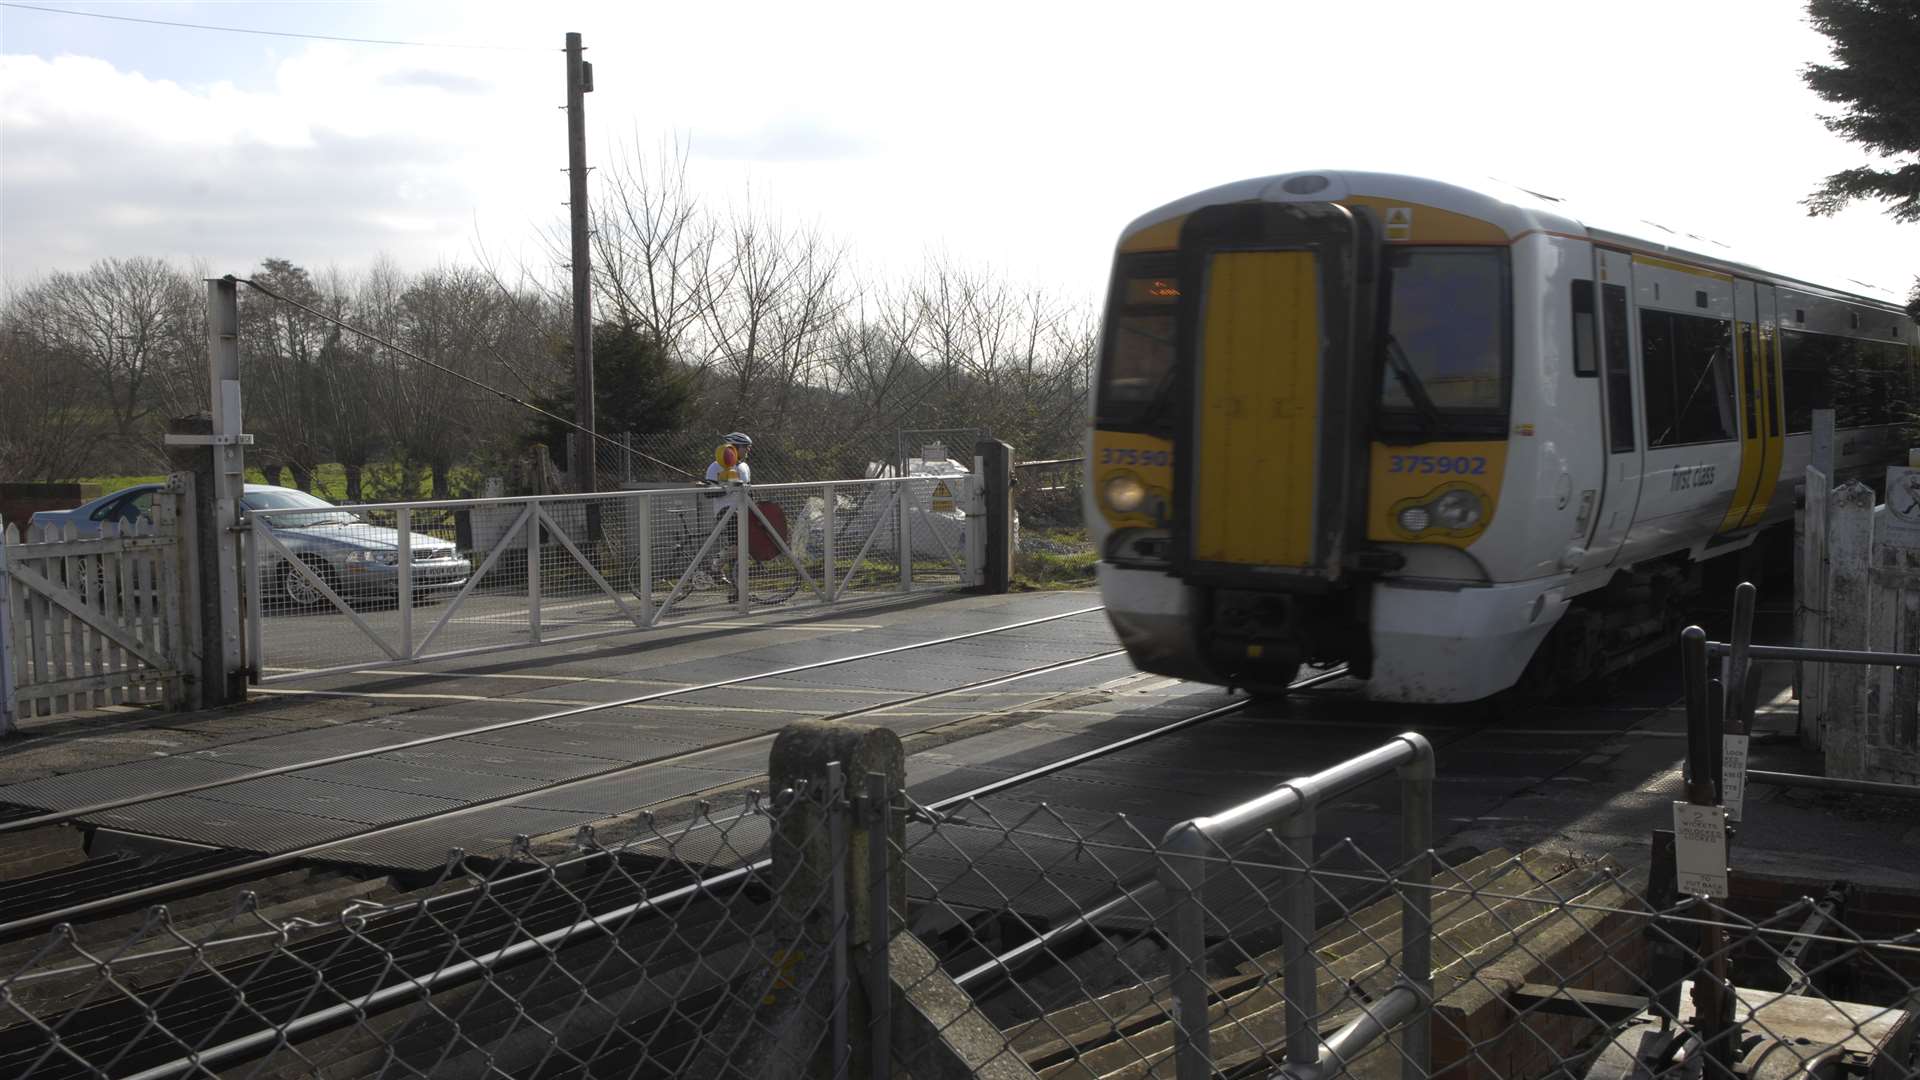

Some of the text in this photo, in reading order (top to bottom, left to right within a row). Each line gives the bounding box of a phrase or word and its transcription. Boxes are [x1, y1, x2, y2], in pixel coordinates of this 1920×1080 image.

[1101, 447, 1175, 467] 37590
[1387, 454, 1487, 476] 375902
[1670, 464, 1716, 492] first class
[1694, 812, 1703, 822] 2
